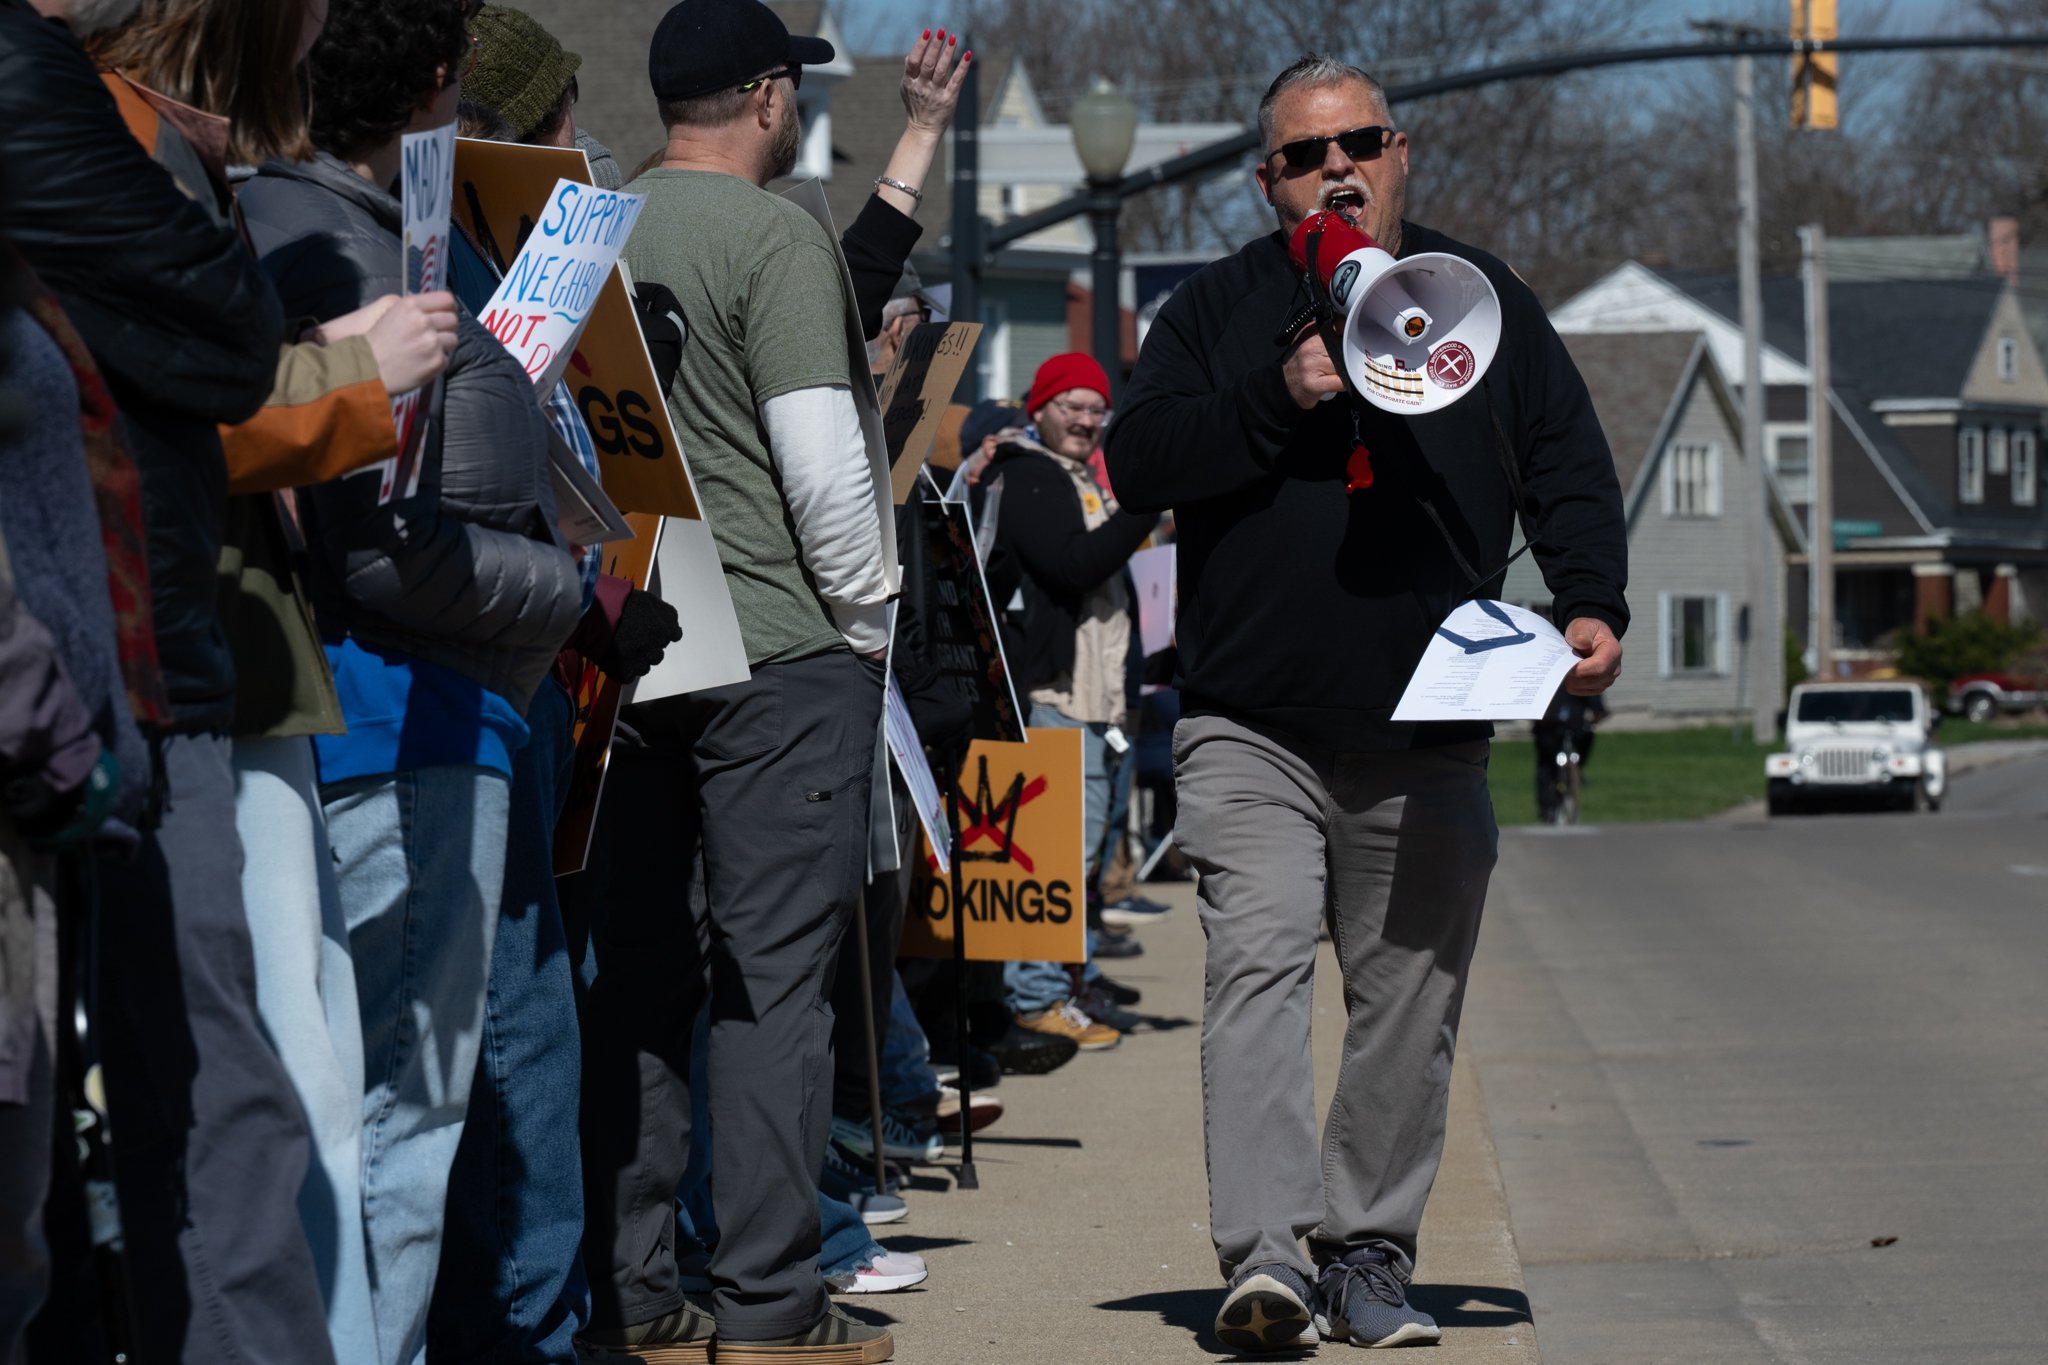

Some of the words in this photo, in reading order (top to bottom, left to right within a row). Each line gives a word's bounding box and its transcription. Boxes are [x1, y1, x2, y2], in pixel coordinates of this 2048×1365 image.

[481, 308, 547, 348] NOT
[1430, 342, 1458, 363] BROTHERHOOD
[1462, 347, 1474, 381] MAINTENANCE
[1366, 386, 1375, 394] FOR
[1375, 391, 1406, 404] CORPORATE
[960, 878, 1073, 924] KINGS
